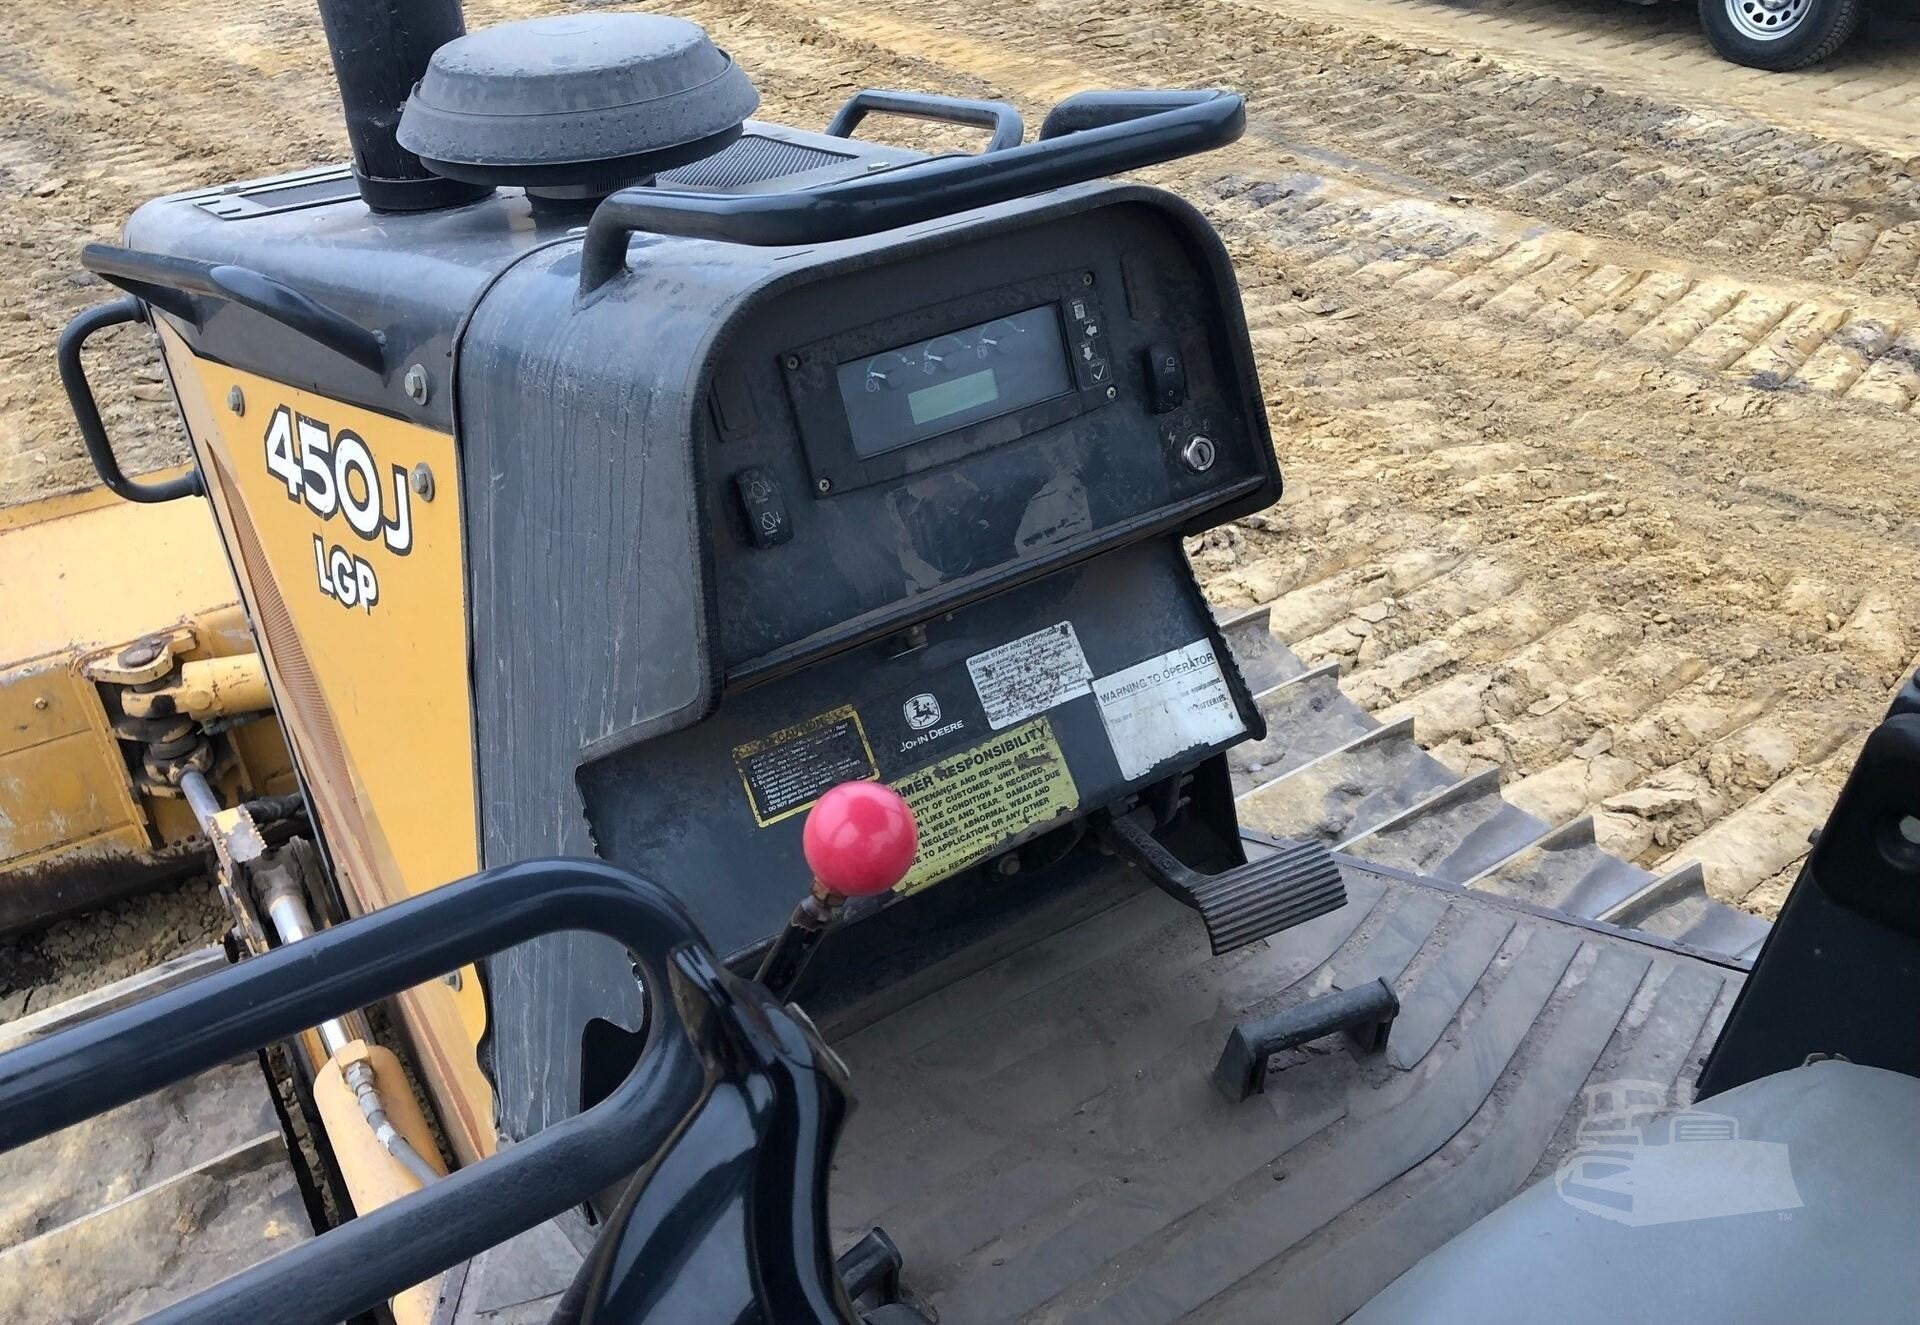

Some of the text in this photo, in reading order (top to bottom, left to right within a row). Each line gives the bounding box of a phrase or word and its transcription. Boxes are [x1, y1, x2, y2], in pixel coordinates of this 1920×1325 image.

[264, 404, 412, 556] 450J
[313, 533, 379, 615] LGP
[1100, 679, 1148, 703] WARNING
[1147, 673, 1161, 685] TO
[1163, 652, 1214, 679] OPERATOR
[900, 720, 964, 752] JOHN DEERE
[932, 800, 943, 810] OF
[945, 779, 993, 803] CUSTOMER.
[997, 767, 1016, 780] UNIT
[960, 774, 977, 787] AND
[979, 758, 1012, 778] REPAIRS
[1013, 751, 1029, 762] ARE
[1031, 743, 1046, 755] THE
[925, 811, 945, 825] LIKE
[946, 790, 992, 814] CONDITION
[993, 784, 1004, 794] AS
[1005, 766, 1046, 788] RECEIVED,
[931, 817, 956, 832] WEAR
[958, 808, 975, 820] AND
[977, 797, 1001, 812] TEAR.
[1005, 777, 1043, 799] DAMAGES
[1044, 769, 1061, 781] DUE
[963, 805, 1008, 829] ABNORMAL
[1009, 793, 1033, 808] WEAR
[1034, 785, 1050, 797] AND
[923, 849, 935, 859] TO
[937, 824, 990, 853] APPLICATION
[991, 818, 1004, 828] OR
[1006, 809, 1021, 822] ANY
[1023, 796, 1050, 813] OTHER
